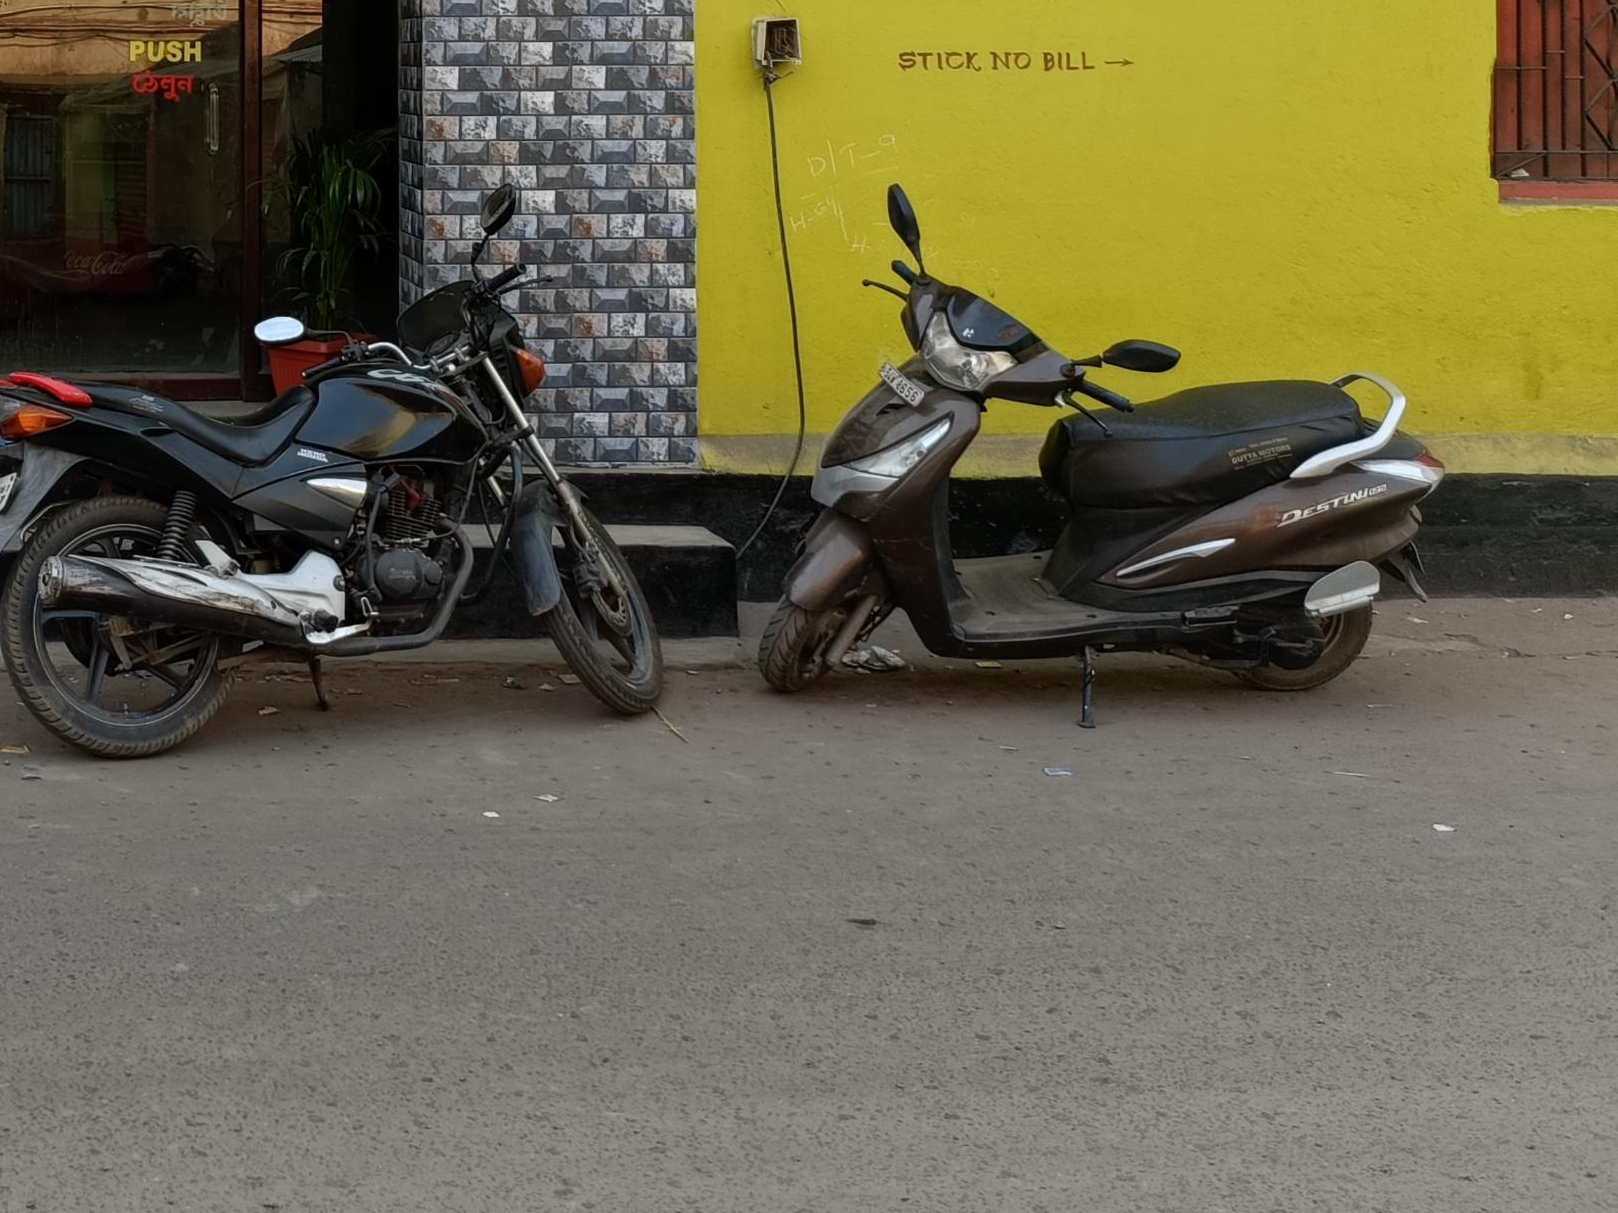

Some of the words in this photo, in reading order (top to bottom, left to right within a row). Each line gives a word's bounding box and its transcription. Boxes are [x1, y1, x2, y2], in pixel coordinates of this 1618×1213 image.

[129, 40, 202, 62] PUSH
[898, 50, 982, 72] STICK
[989, 51, 1032, 71] NO
[1043, 51, 1095, 72] BILL
